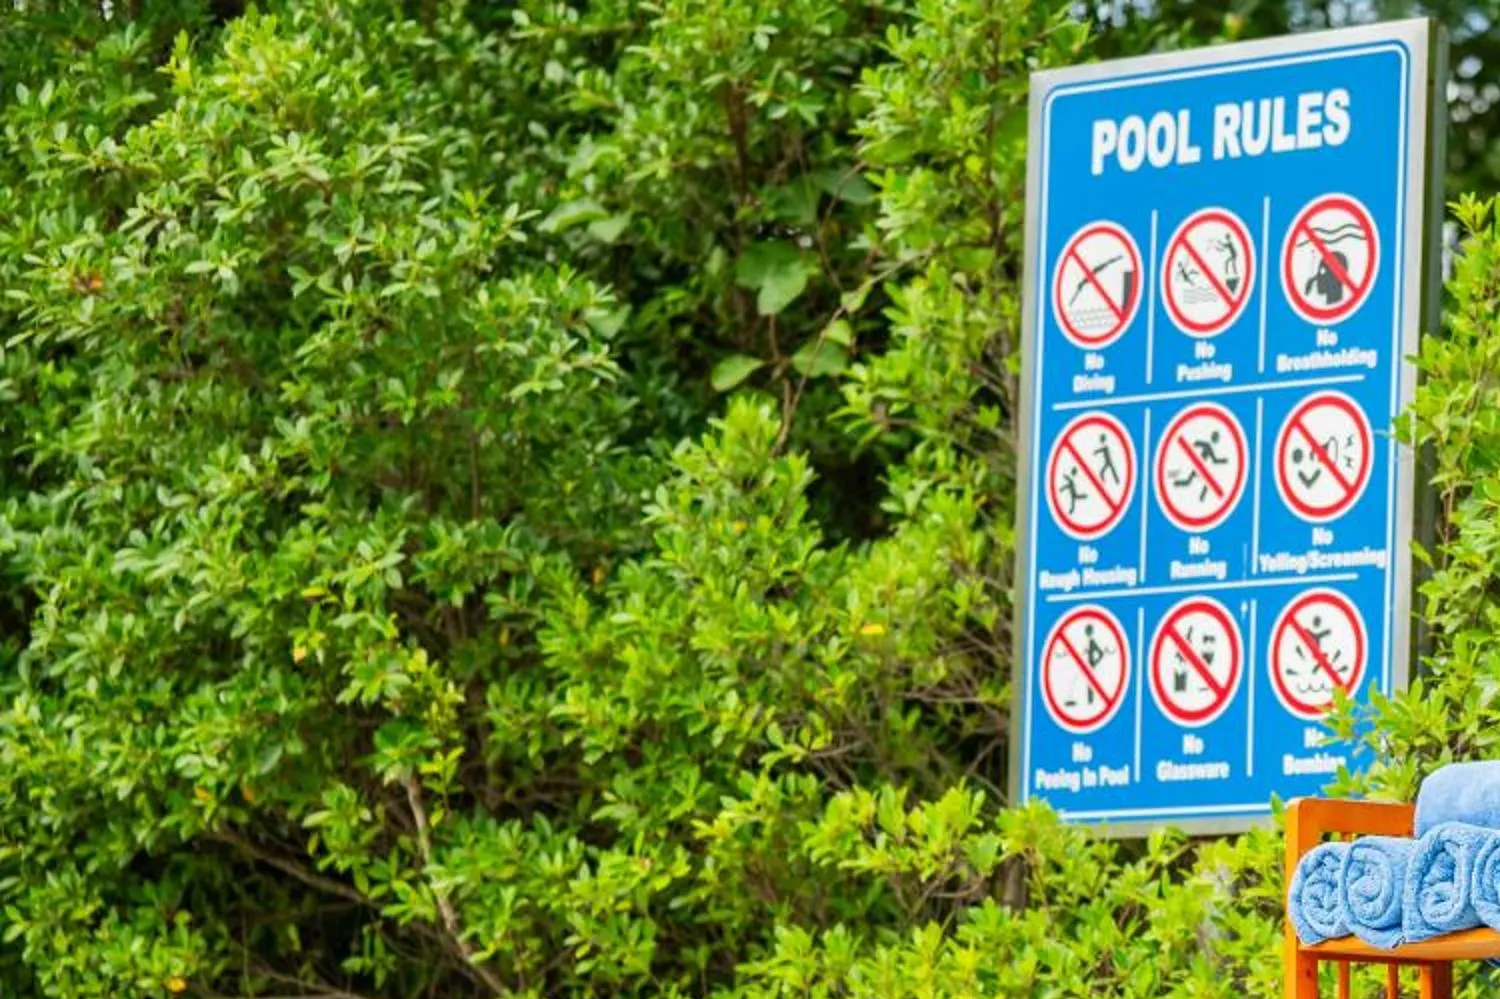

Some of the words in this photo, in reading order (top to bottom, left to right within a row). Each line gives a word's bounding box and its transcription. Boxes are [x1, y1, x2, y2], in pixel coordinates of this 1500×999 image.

[1092, 110, 1200, 175] POOL
[1213, 89, 1350, 160] RULES
[1317, 329, 1337, 346] No
[1195, 341, 1215, 358] No
[1085, 353, 1104, 370] No
[1177, 362, 1232, 381] Pushing
[1189, 537, 1209, 554] No
[1312, 528, 1333, 545] No
[1078, 546, 1098, 563] No
[1171, 560, 1226, 580] Running
[1072, 743, 1092, 761] No
[1183, 735, 1203, 754] No
[1099, 766, 1129, 785] Pool
[1157, 761, 1229, 781] Glassware
